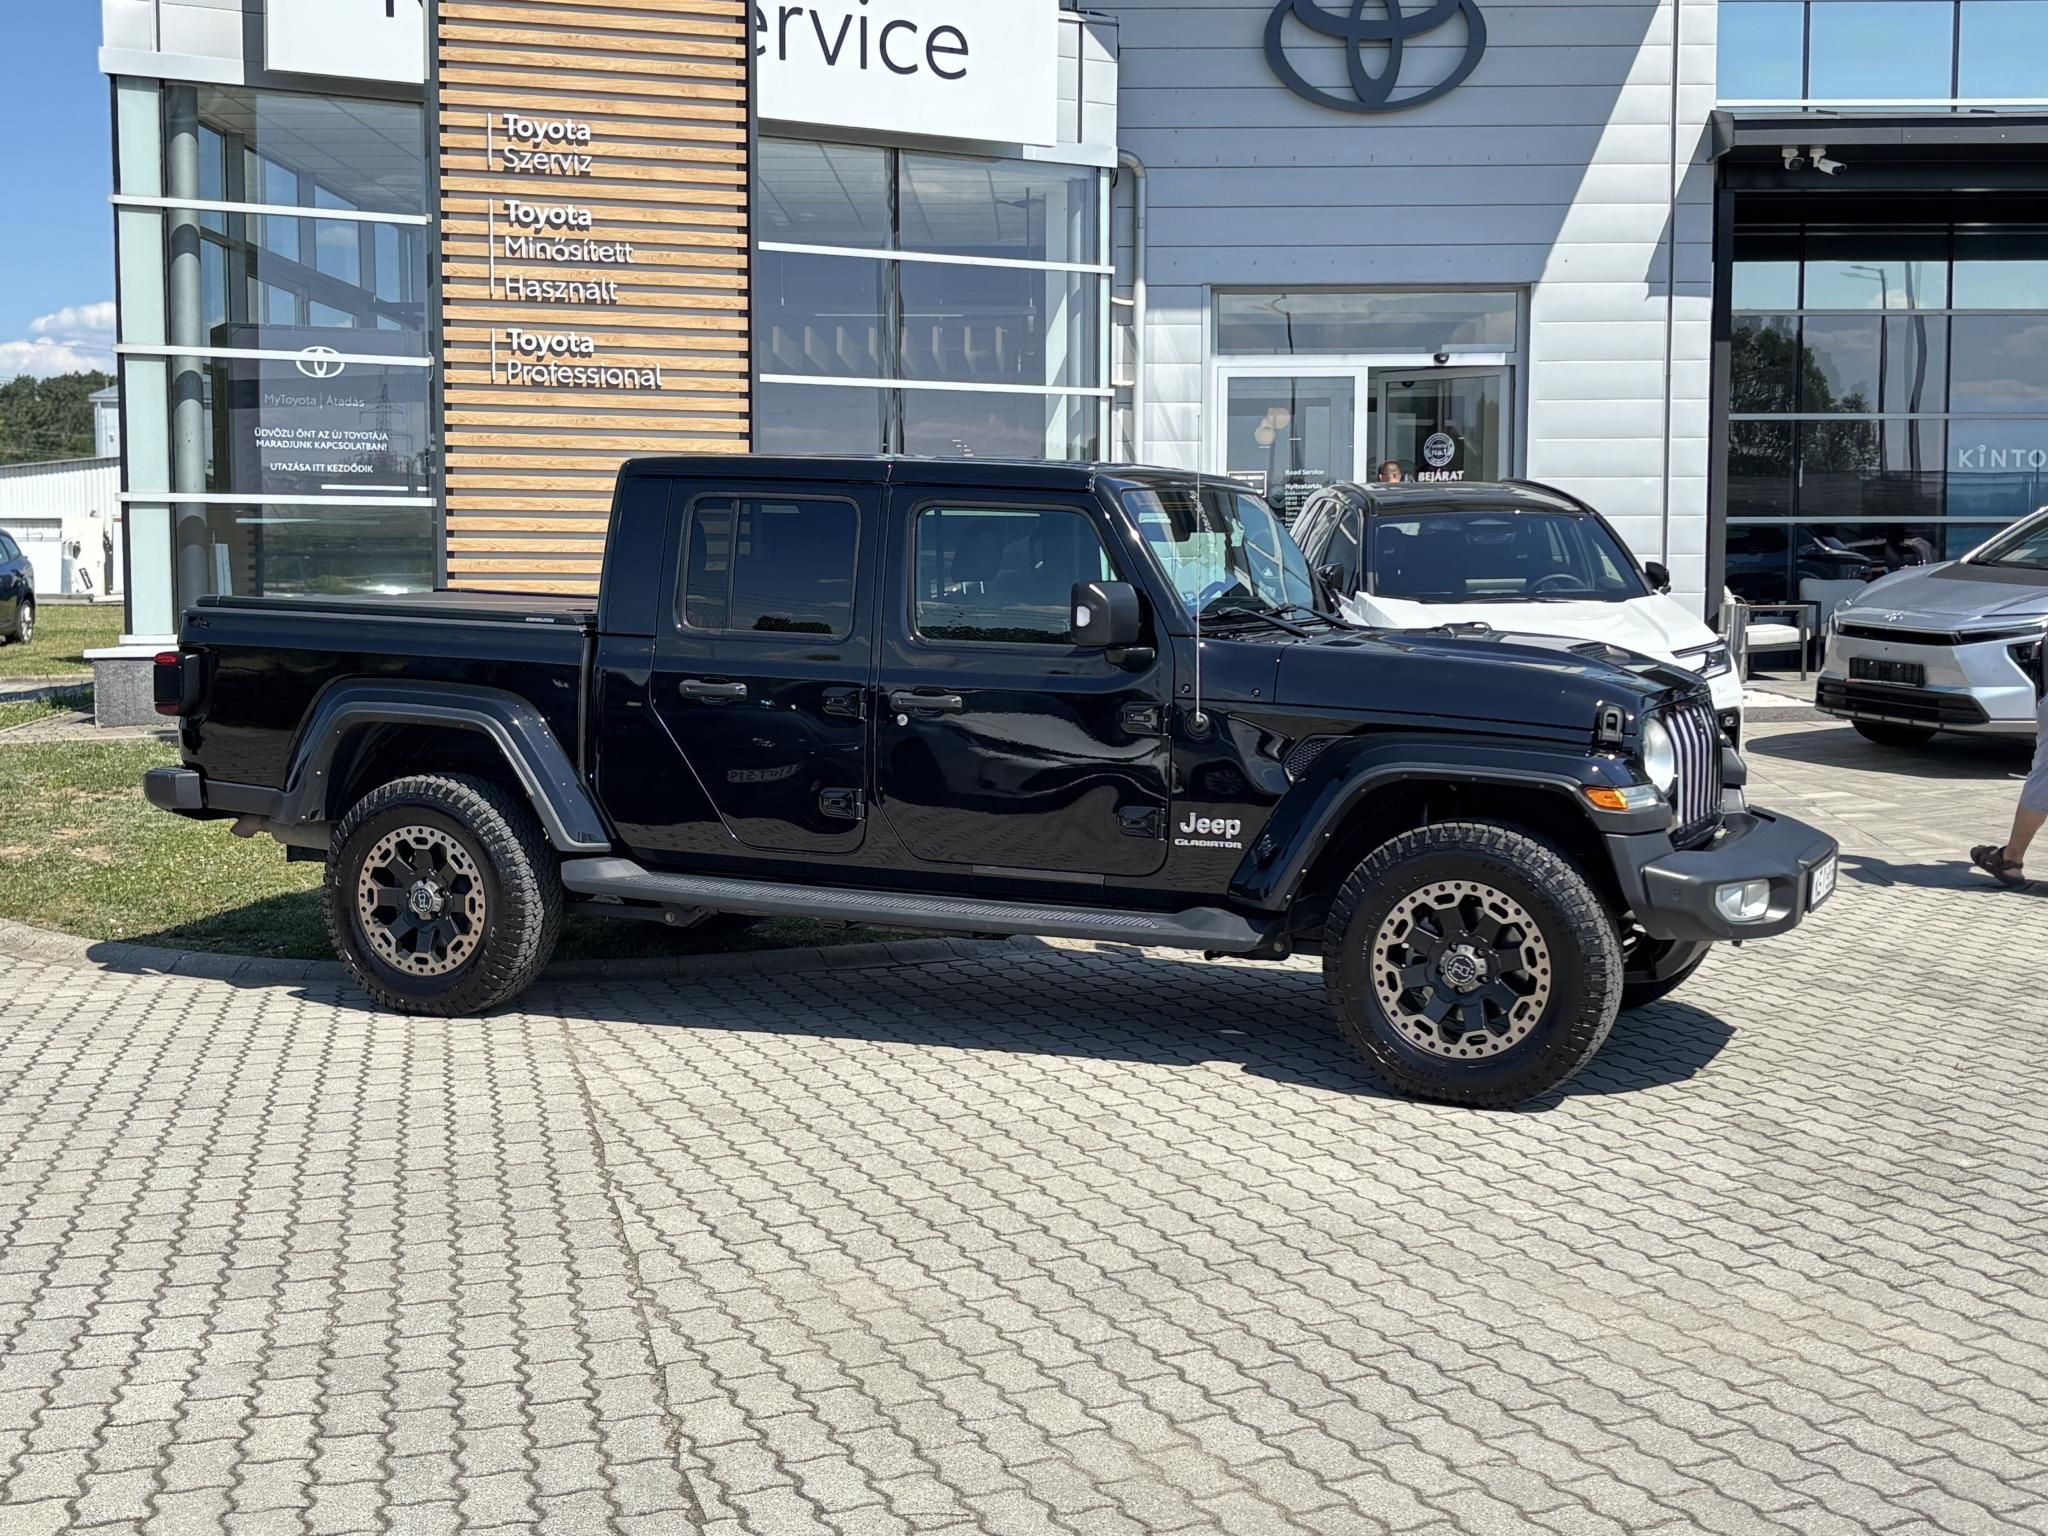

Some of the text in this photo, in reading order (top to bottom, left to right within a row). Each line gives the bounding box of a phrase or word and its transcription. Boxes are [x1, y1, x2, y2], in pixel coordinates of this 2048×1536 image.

[757, 0, 969, 80] rvice
[503, 113, 591, 144] Toyota
[503, 145, 592, 173] Szerviz
[504, 199, 592, 229] Toyota
[505, 235, 635, 263] Minősített
[505, 273, 619, 301] Használt
[507, 328, 595, 357] Toyota
[507, 359, 663, 387] Professional
[264, 393, 317, 407] MyToyota
[254, 427, 389, 441] ÜDVÖZLI ÖNT AZ ÚJ TOYOTÁJA
[256, 439, 388, 451] MARADJUNK KAPCSOLATBAN!
[270, 462, 311, 472] UTAZÁSA
[312, 463, 326, 472] ITT
[1418, 468, 1464, 483] BEJÁRAT
[1179, 812, 1241, 839] Jeep
[1174, 838, 1242, 849] GLADIATOR
